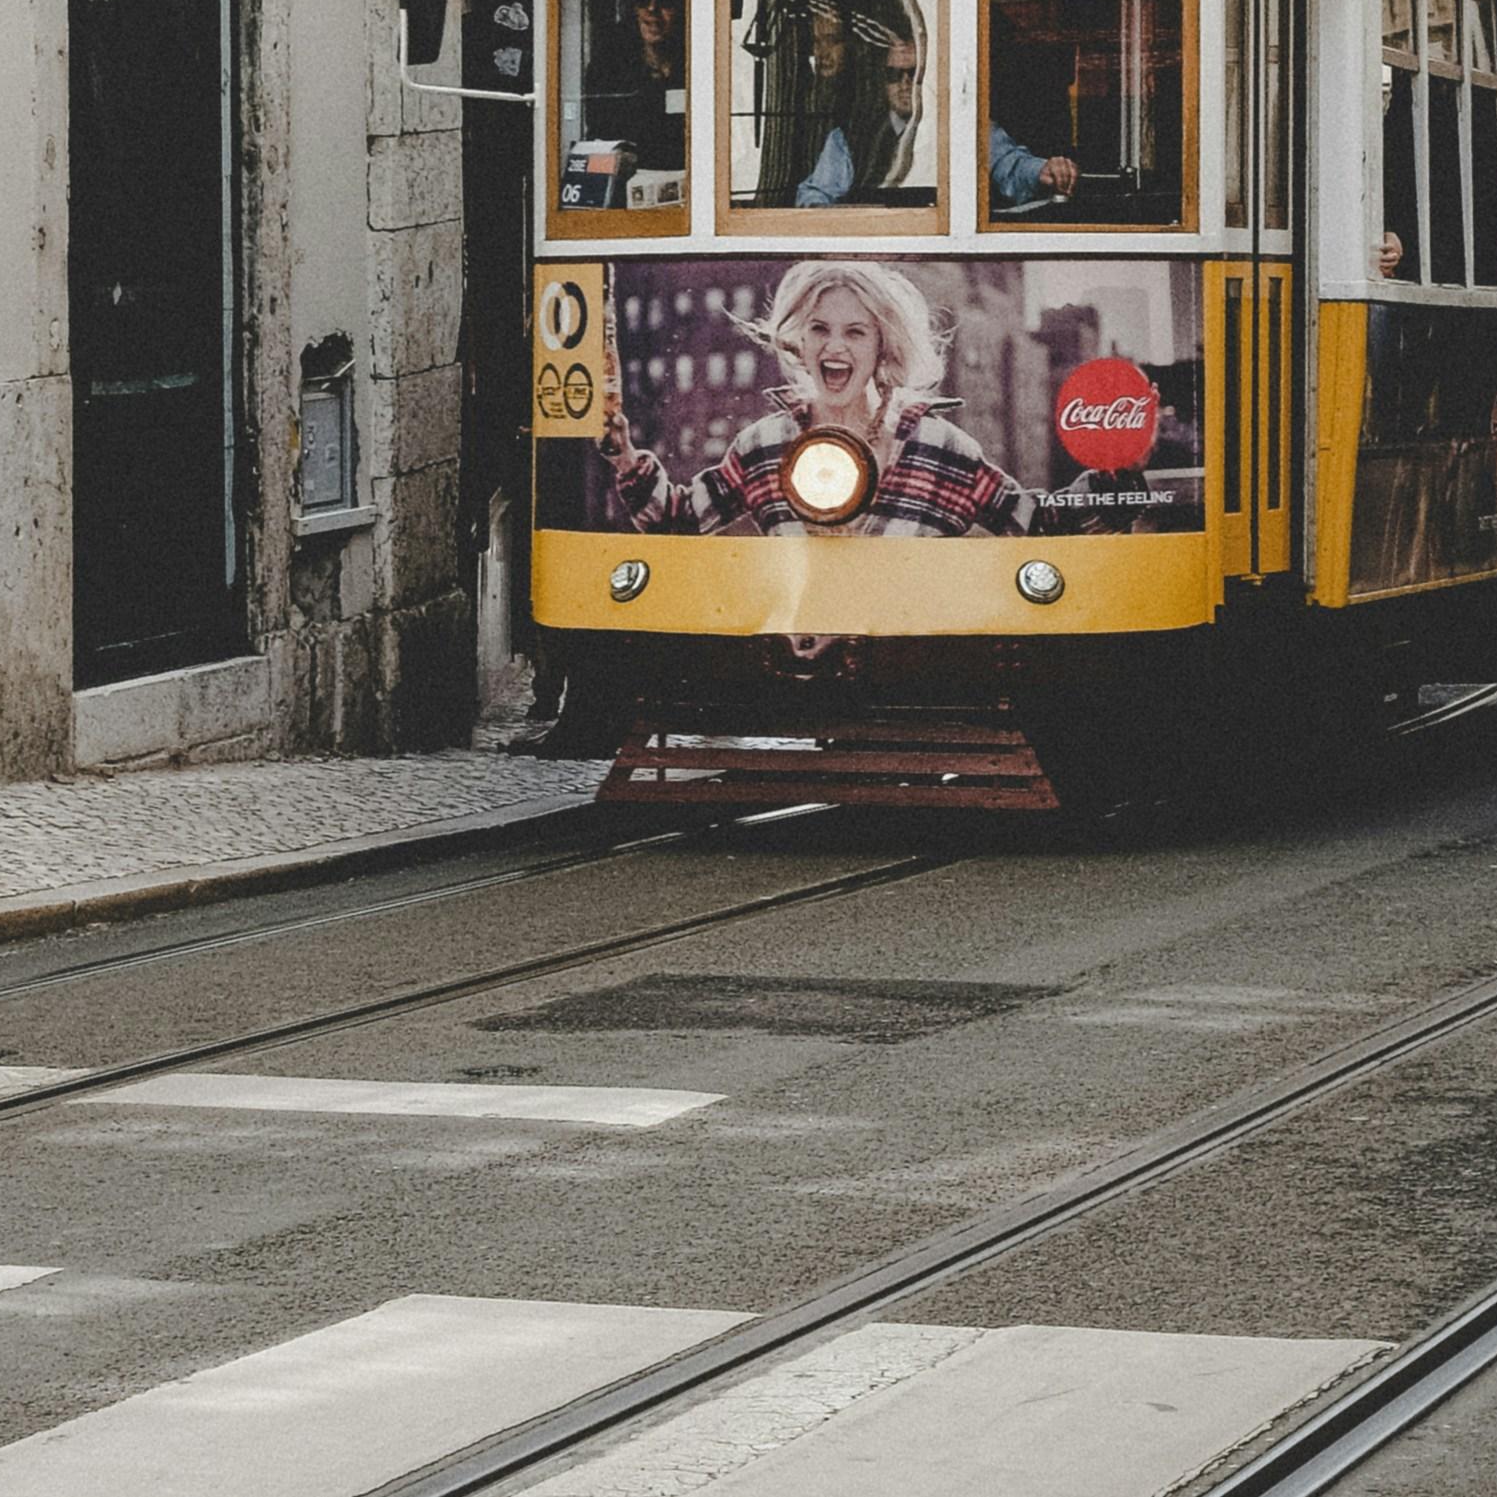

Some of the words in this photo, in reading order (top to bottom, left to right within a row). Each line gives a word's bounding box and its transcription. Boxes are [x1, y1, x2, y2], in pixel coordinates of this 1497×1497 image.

[561, 184, 582, 203] 06
[1060, 397, 1152, 431] Coca-Cola
[1036, 493, 1085, 507] TASTE
[1087, 492, 1115, 506] THE
[1117, 490, 1174, 505] FEELING
